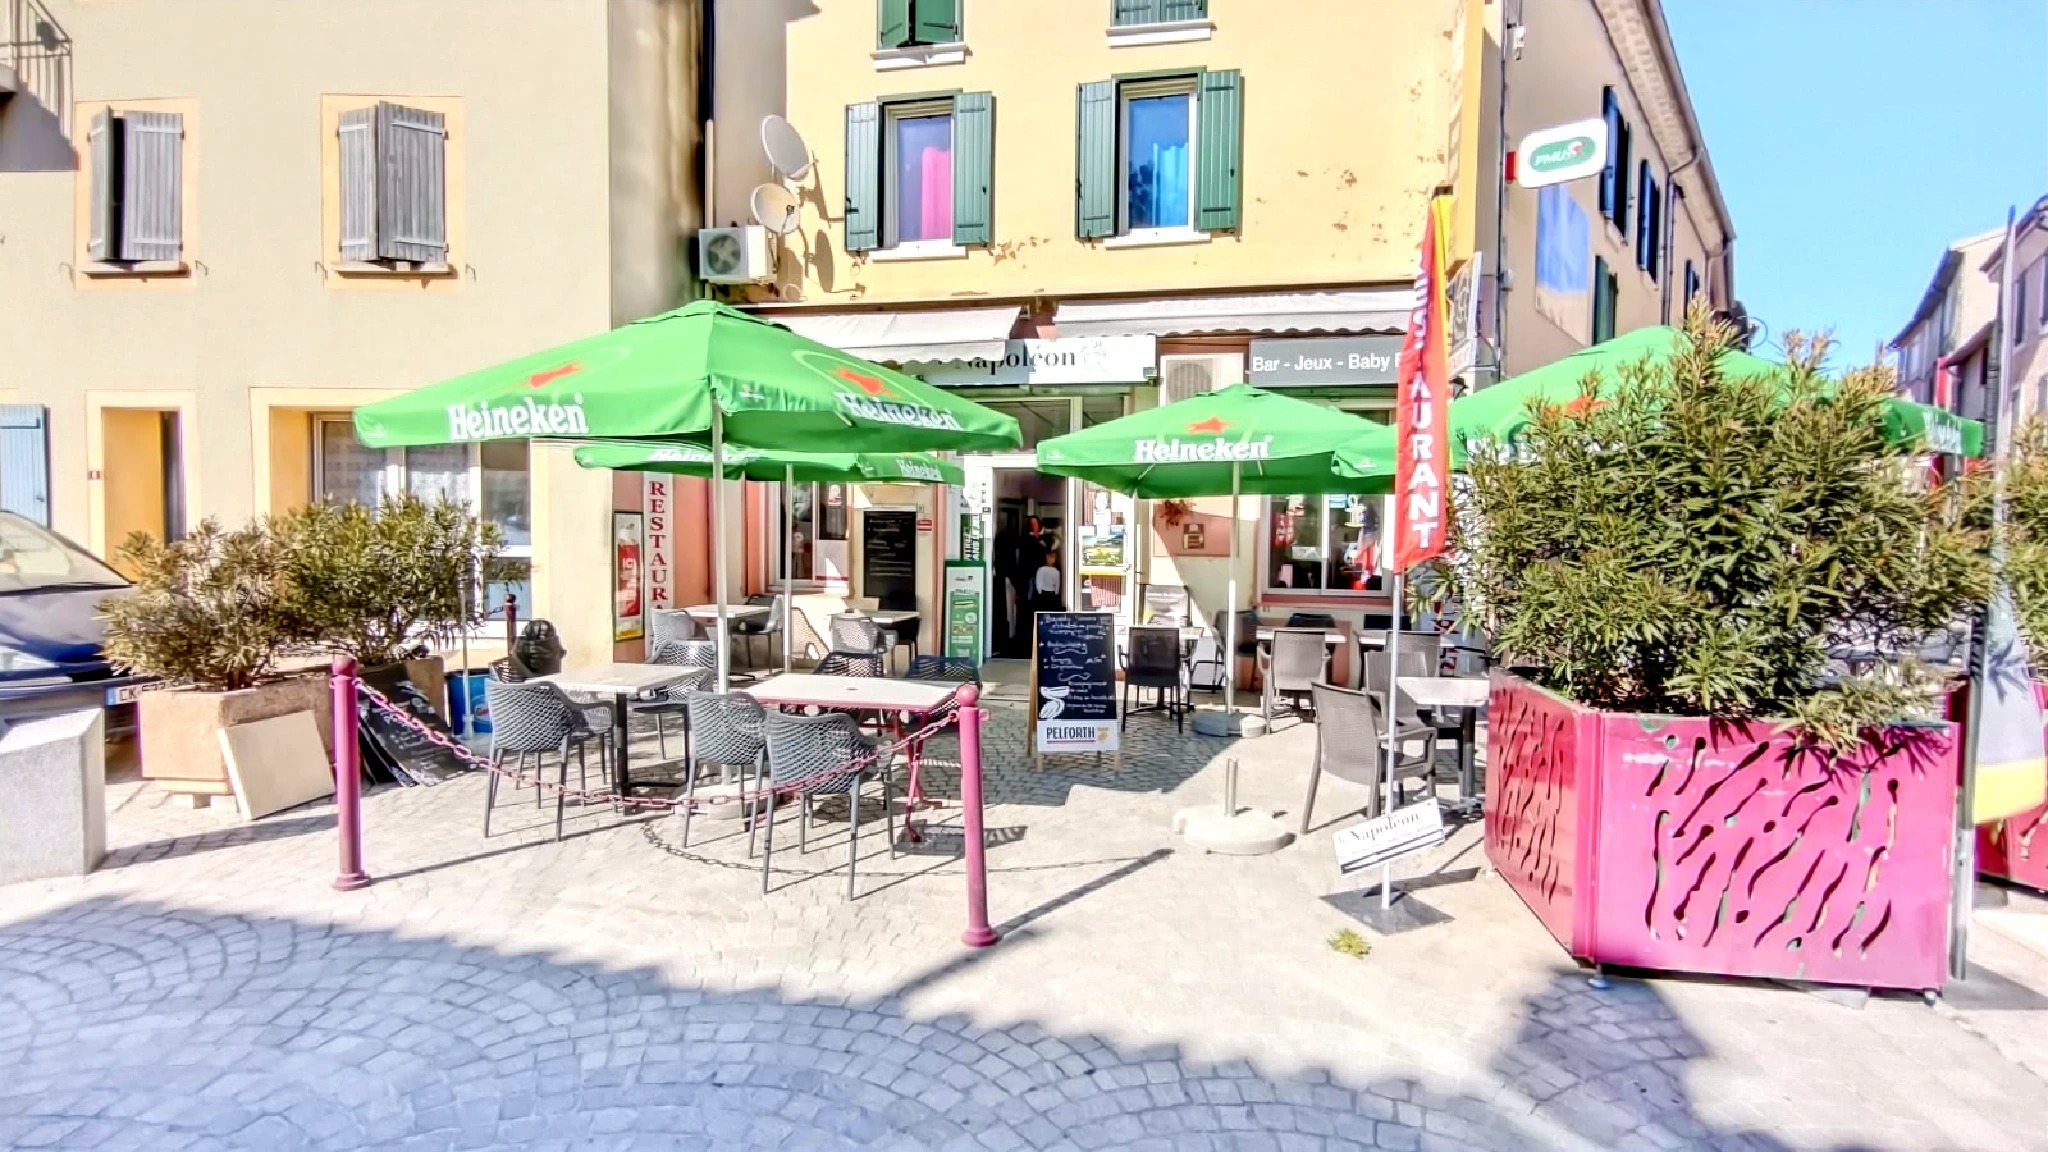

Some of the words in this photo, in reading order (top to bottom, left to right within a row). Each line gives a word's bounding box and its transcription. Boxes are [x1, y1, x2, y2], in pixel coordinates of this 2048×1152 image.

[1252, 356, 1280, 372] Bar
[1294, 355, 1332, 371] Jeux
[1349, 353, 1391, 372] Baby
[834, 392, 963, 431] Heineken
[1409, 248, 1441, 548] ESAURANT
[448, 397, 589, 440] Heineken
[1135, 438, 1268, 462] Heineken
[649, 480, 668, 609] RESTAUR
[1047, 727, 1095, 740] PELFORTH
